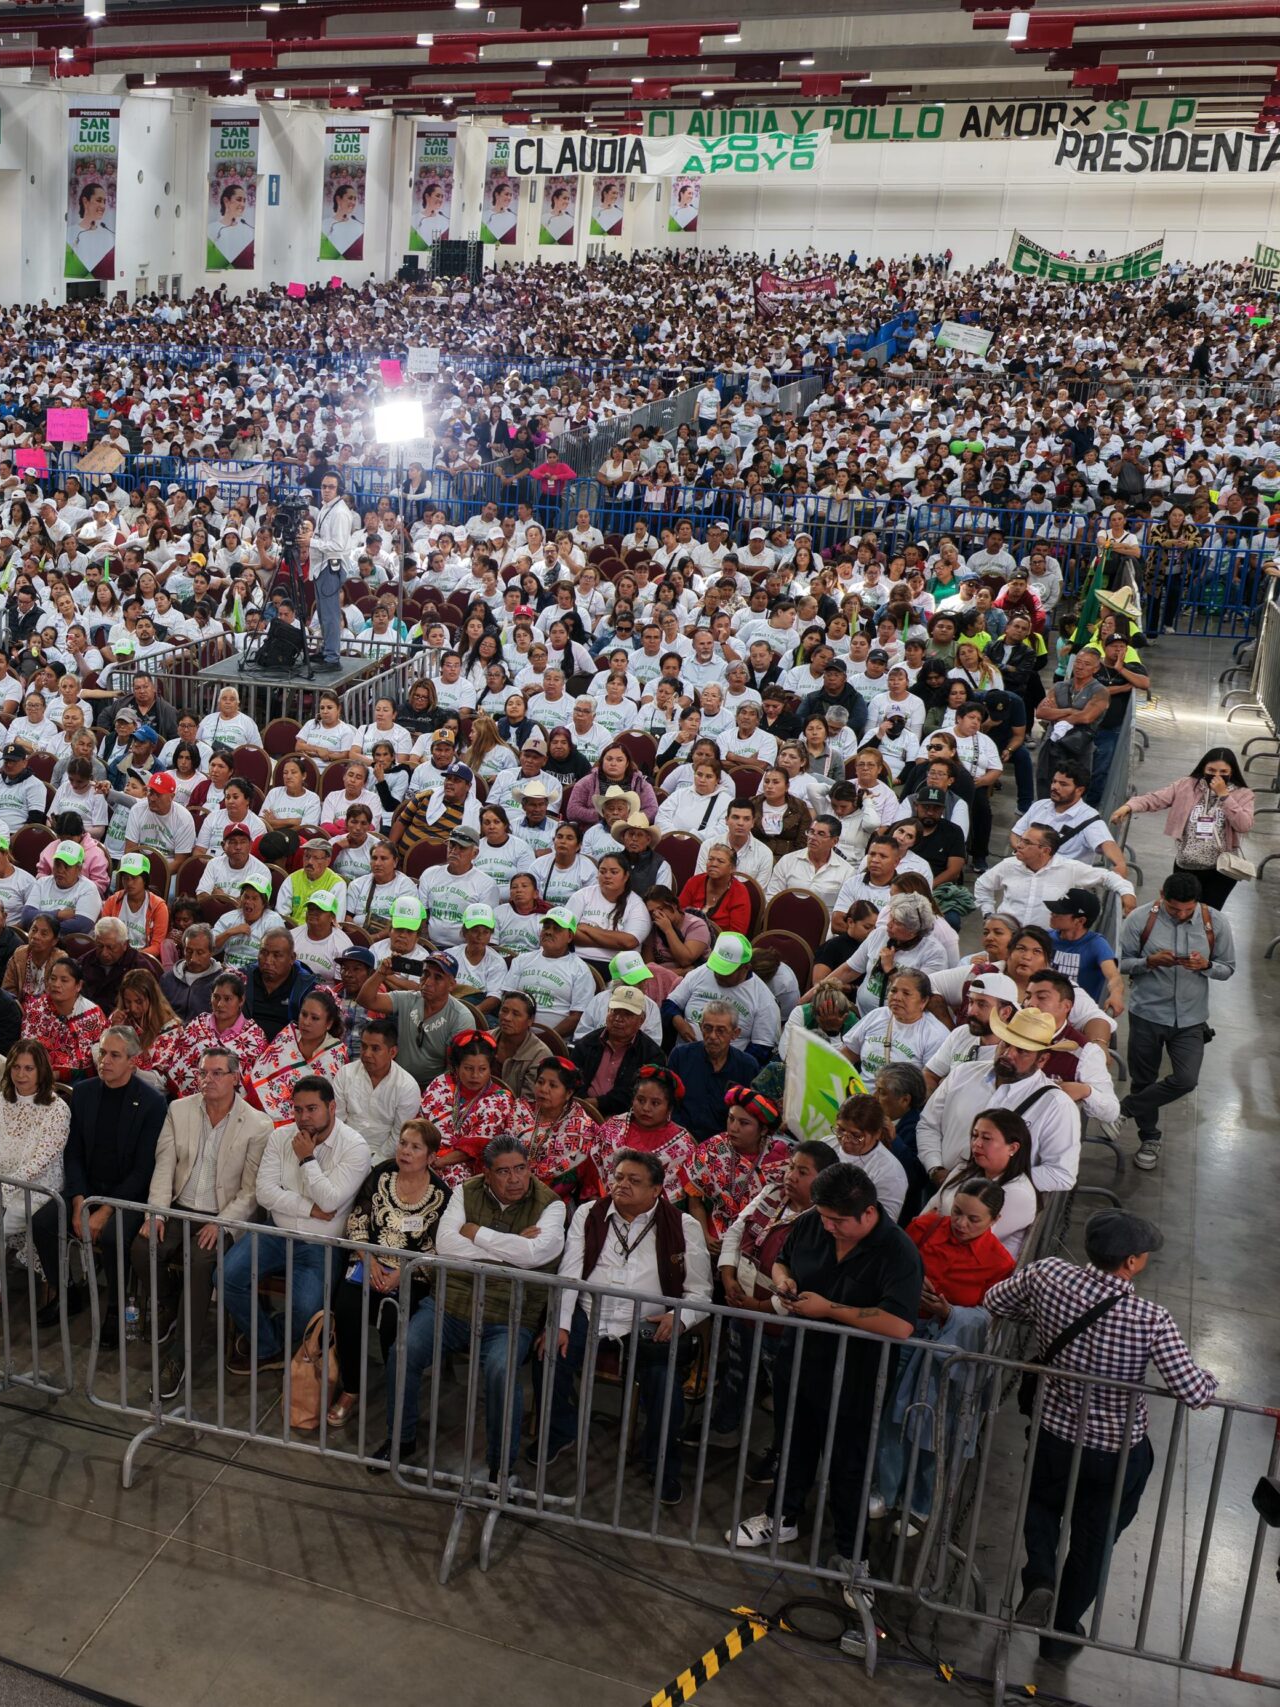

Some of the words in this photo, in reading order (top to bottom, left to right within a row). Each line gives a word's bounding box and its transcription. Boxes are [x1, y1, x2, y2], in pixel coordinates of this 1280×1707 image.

[80, 118, 109, 130] SAN
[648, 109, 779, 137] CLAUDIA
[790, 109, 815, 134] Y
[823, 106, 944, 141] POLLO
[960, 103, 1067, 138] AMOR
[79, 131, 111, 143] LUIS
[221, 127, 249, 138] SAN
[335, 133, 361, 143] SAN
[220, 139, 250, 149] LUIS
[425, 137, 448, 146] SAN
[496, 142, 509, 150] SA
[699, 133, 758, 153] YO
[769, 132, 819, 150] TE
[73, 144, 116, 153] CONTIGO
[334, 144, 361, 153] LUIS
[424, 147, 448, 156] LUIS
[514, 135, 647, 175] CLAUDIA
[681, 151, 815, 174] APOYO
[1255, 244, 1280, 268] LOS
[1012, 244, 1164, 283] Claudia
[1251, 267, 1280, 291] NUE
[8, 746, 15, 754] P
[929, 790, 938, 799] M
